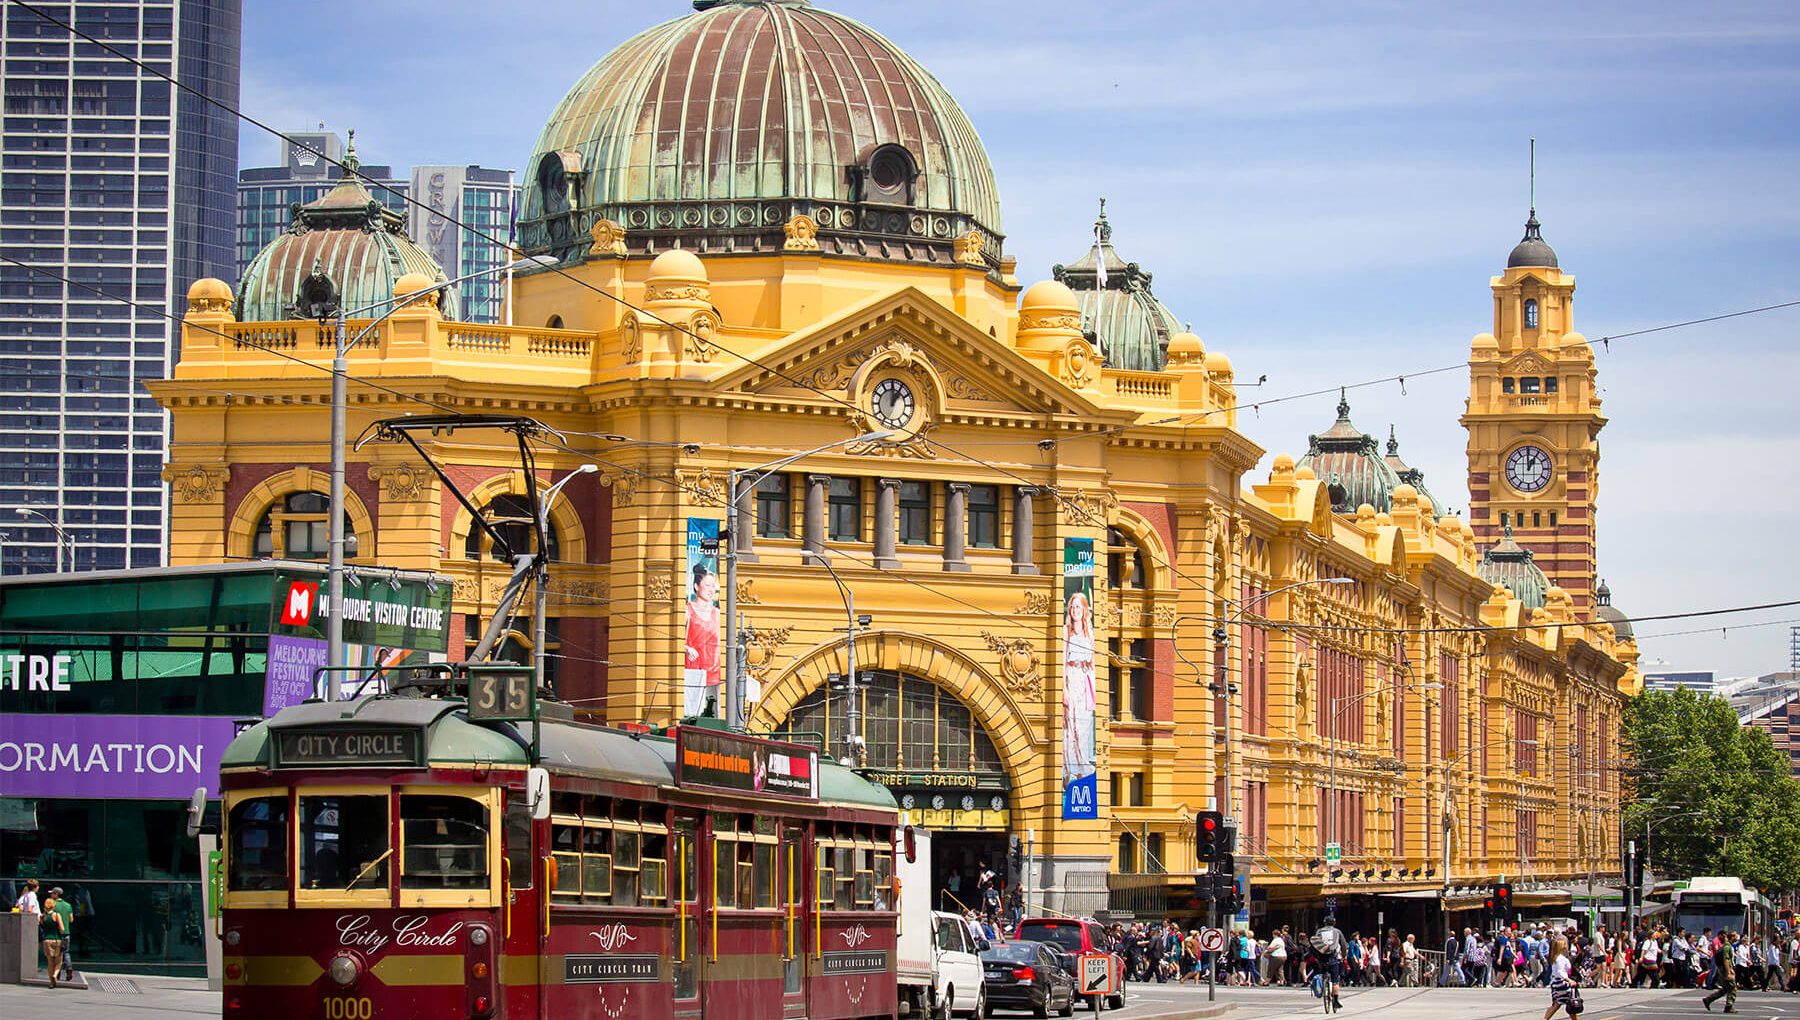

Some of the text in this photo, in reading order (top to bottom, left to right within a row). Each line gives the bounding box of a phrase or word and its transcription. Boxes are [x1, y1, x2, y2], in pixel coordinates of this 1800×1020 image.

[429, 171, 446, 262] CROWN
[689, 532, 704, 544] my
[1078, 551, 1093, 562] my
[1065, 563, 1093, 573] metro
[319, 594, 443, 630] MOURNE VISITOR CENTRE
[273, 644, 327, 666] MELBOURNE
[0, 655, 71, 691] TRE
[272, 662, 309, 681] FESTIVAL
[290, 682, 305, 696] OCT
[478, 675, 528, 709] 35
[297, 734, 403, 755] CITY CIRCLE
[0, 742, 204, 774] ORMATION
[924, 775, 977, 787] STATION
[336, 915, 463, 955] City Circle
[572, 964, 651, 974] CITY CIRCLE TRAM
[323, 997, 372, 1020] 1000
